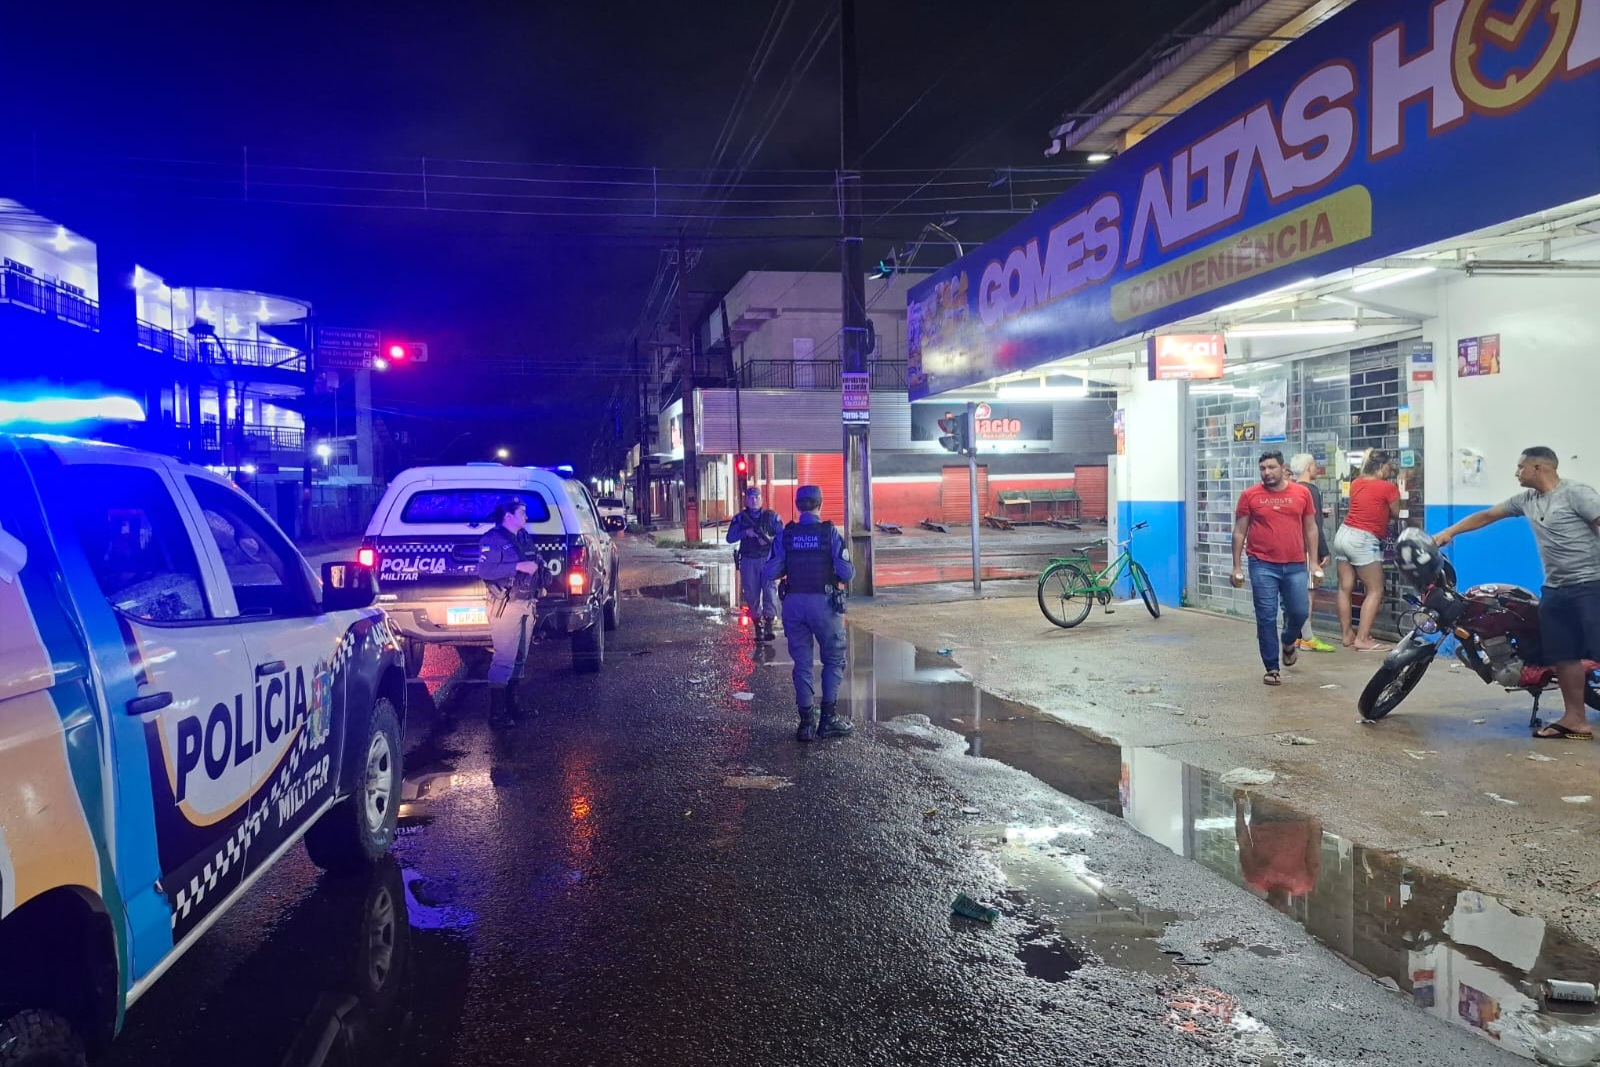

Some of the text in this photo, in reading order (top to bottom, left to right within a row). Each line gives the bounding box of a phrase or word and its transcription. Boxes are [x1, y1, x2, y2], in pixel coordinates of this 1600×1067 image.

[979, 195, 1120, 326] GOMES
[1126, 64, 1354, 265] ALTAS
[1130, 211, 1334, 313] CONVENIÊNCIA
[1160, 335, 1218, 361] Açaí
[793, 534, 818, 542] POLÍCIA
[380, 555, 446, 572] POLÍCIA
[380, 572, 418, 581] MILITAR
[175, 664, 307, 805] POLÍCIA
[278, 754, 330, 828] MILITAR
